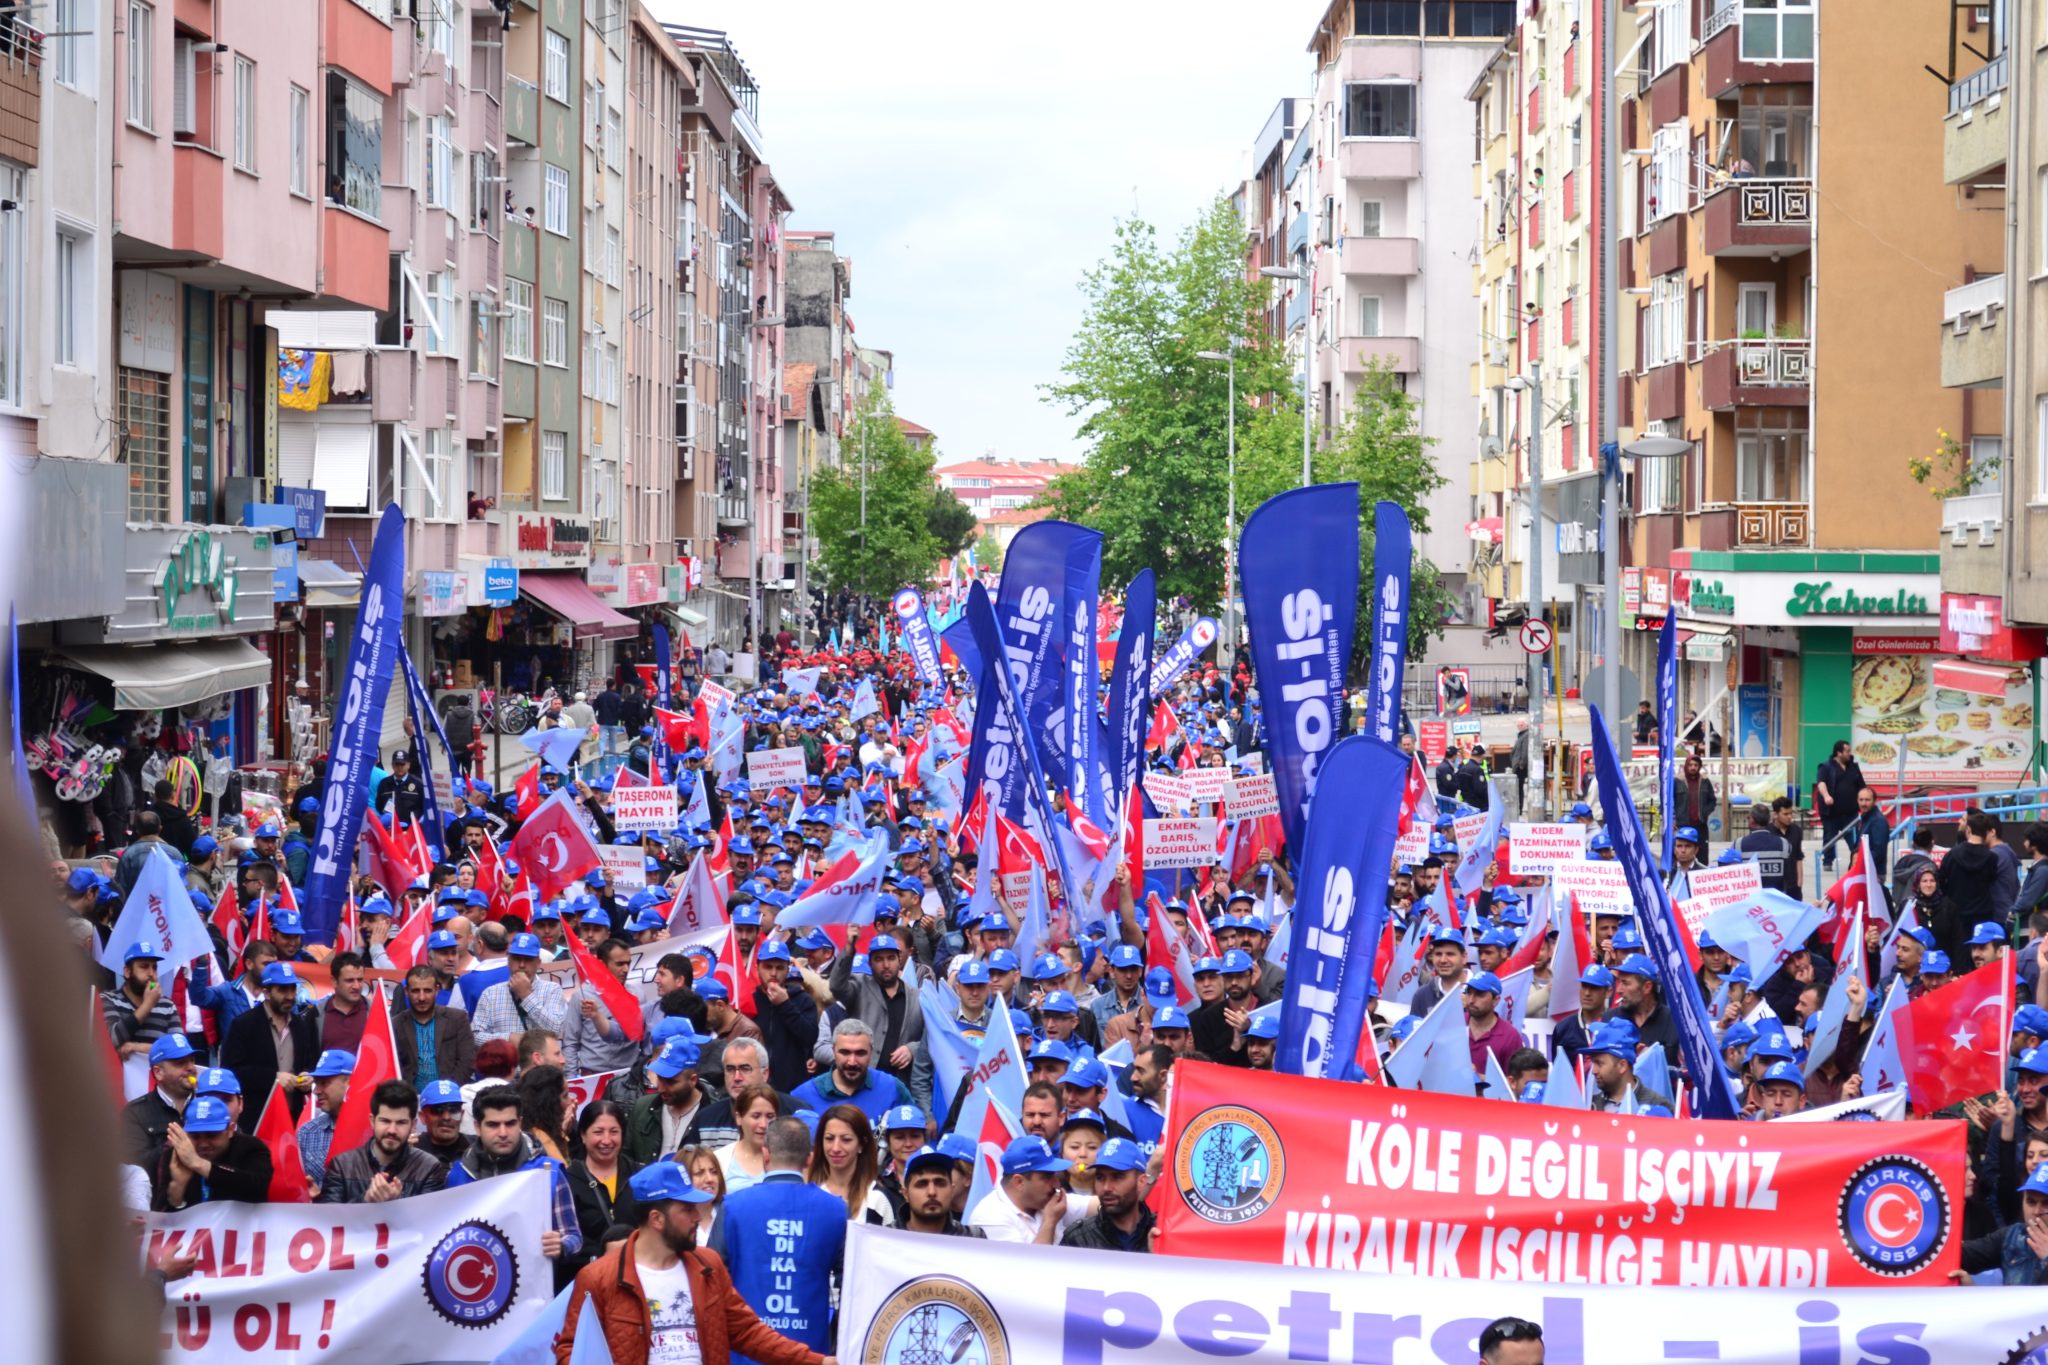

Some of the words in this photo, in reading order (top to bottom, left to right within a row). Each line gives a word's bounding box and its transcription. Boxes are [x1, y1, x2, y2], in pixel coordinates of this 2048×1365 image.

[488, 576, 513, 586] beko
[1786, 581, 1928, 617] Kahvaltı
[1038, 621, 1051, 660] Sendikası
[1856, 637, 1876, 649] Özel
[313, 582, 384, 877] petrol-iş
[335, 819, 347, 856] Türkiye
[344, 786, 353, 814] Petrol
[349, 750, 361, 781] Kimya
[355, 716, 366, 745] Lastik
[368, 627, 383, 674] Sendikası
[1236, 777, 1273, 789] EKMEK,
[618, 790, 673, 806] TAŞERONA
[618, 807, 664, 818] HAYIR
[624, 820, 667, 830] petrol-iş
[1158, 822, 1201, 831] EKMEK,
[1531, 827, 1564, 835] KIDEM
[1160, 833, 1198, 843] BARIŞ,
[1513, 838, 1581, 847] TAZMİNATIMA
[1146, 844, 1211, 855] ÖZGÜRLÜK!
[1520, 851, 1574, 859] DOKUNMA!
[1153, 856, 1203, 866] petrol-iş
[1695, 871, 1741, 884] GÜVENCELİ
[1693, 883, 1730, 896] İNSANCA
[1732, 880, 1758, 892] YAŞAM
[1297, 865, 1356, 1078] ol-iş
[1346, 1104, 1480, 1194] KÖLE
[1479, 1121, 1608, 1202] DEĞİL
[1624, 1132, 1782, 1225] İŞÇİYİZ
[1855, 1168, 1933, 1203] TÜRK-İŞ
[1239, 1202, 1264, 1219] 1950
[766, 1219, 804, 1237] SEN
[432, 1229, 504, 1263] TÜRK-İŞ
[775, 1236, 794, 1254] Dİ
[1283, 1195, 1463, 1282] KİRALIK
[150, 1226, 266, 1278] KALI
[288, 1225, 355, 1273] OL
[374, 1223, 390, 1270] !
[1869, 1245, 1920, 1263] 1952
[770, 1257, 796, 1272] KA
[775, 1275, 792, 1291] LI
[452, 1299, 498, 1318] 1952
[766, 1294, 799, 1314] OL
[876, 1304, 904, 1339] PETROL
[905, 1287, 934, 1304] KİMYA
[935, 1287, 968, 1306] LASTİK
[233, 1301, 301, 1352] OL
[317, 1299, 337, 1350] !
[791, 1317, 808, 1330] OL!
[652, 1345, 685, 1354] OCALS
